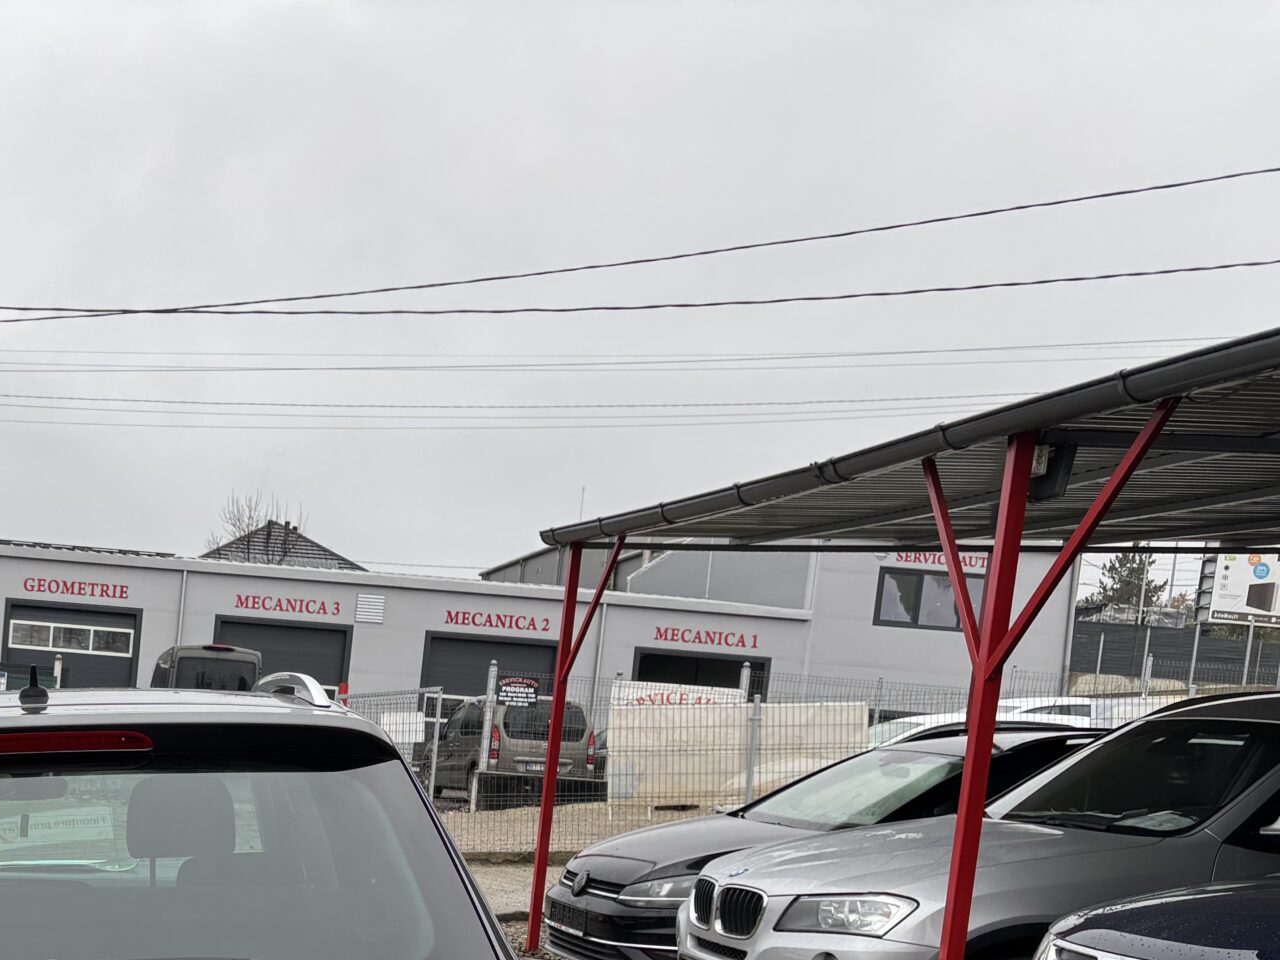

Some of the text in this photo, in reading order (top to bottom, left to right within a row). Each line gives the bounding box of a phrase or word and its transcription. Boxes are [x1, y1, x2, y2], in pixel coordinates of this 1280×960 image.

[896, 551, 989, 568] SERVIC AUT
[23, 577, 129, 599] GEOMETRIE
[234, 594, 341, 616] MECANICA 3
[445, 610, 551, 632] MECANICA 2
[654, 626, 759, 649] MECANICA 1
